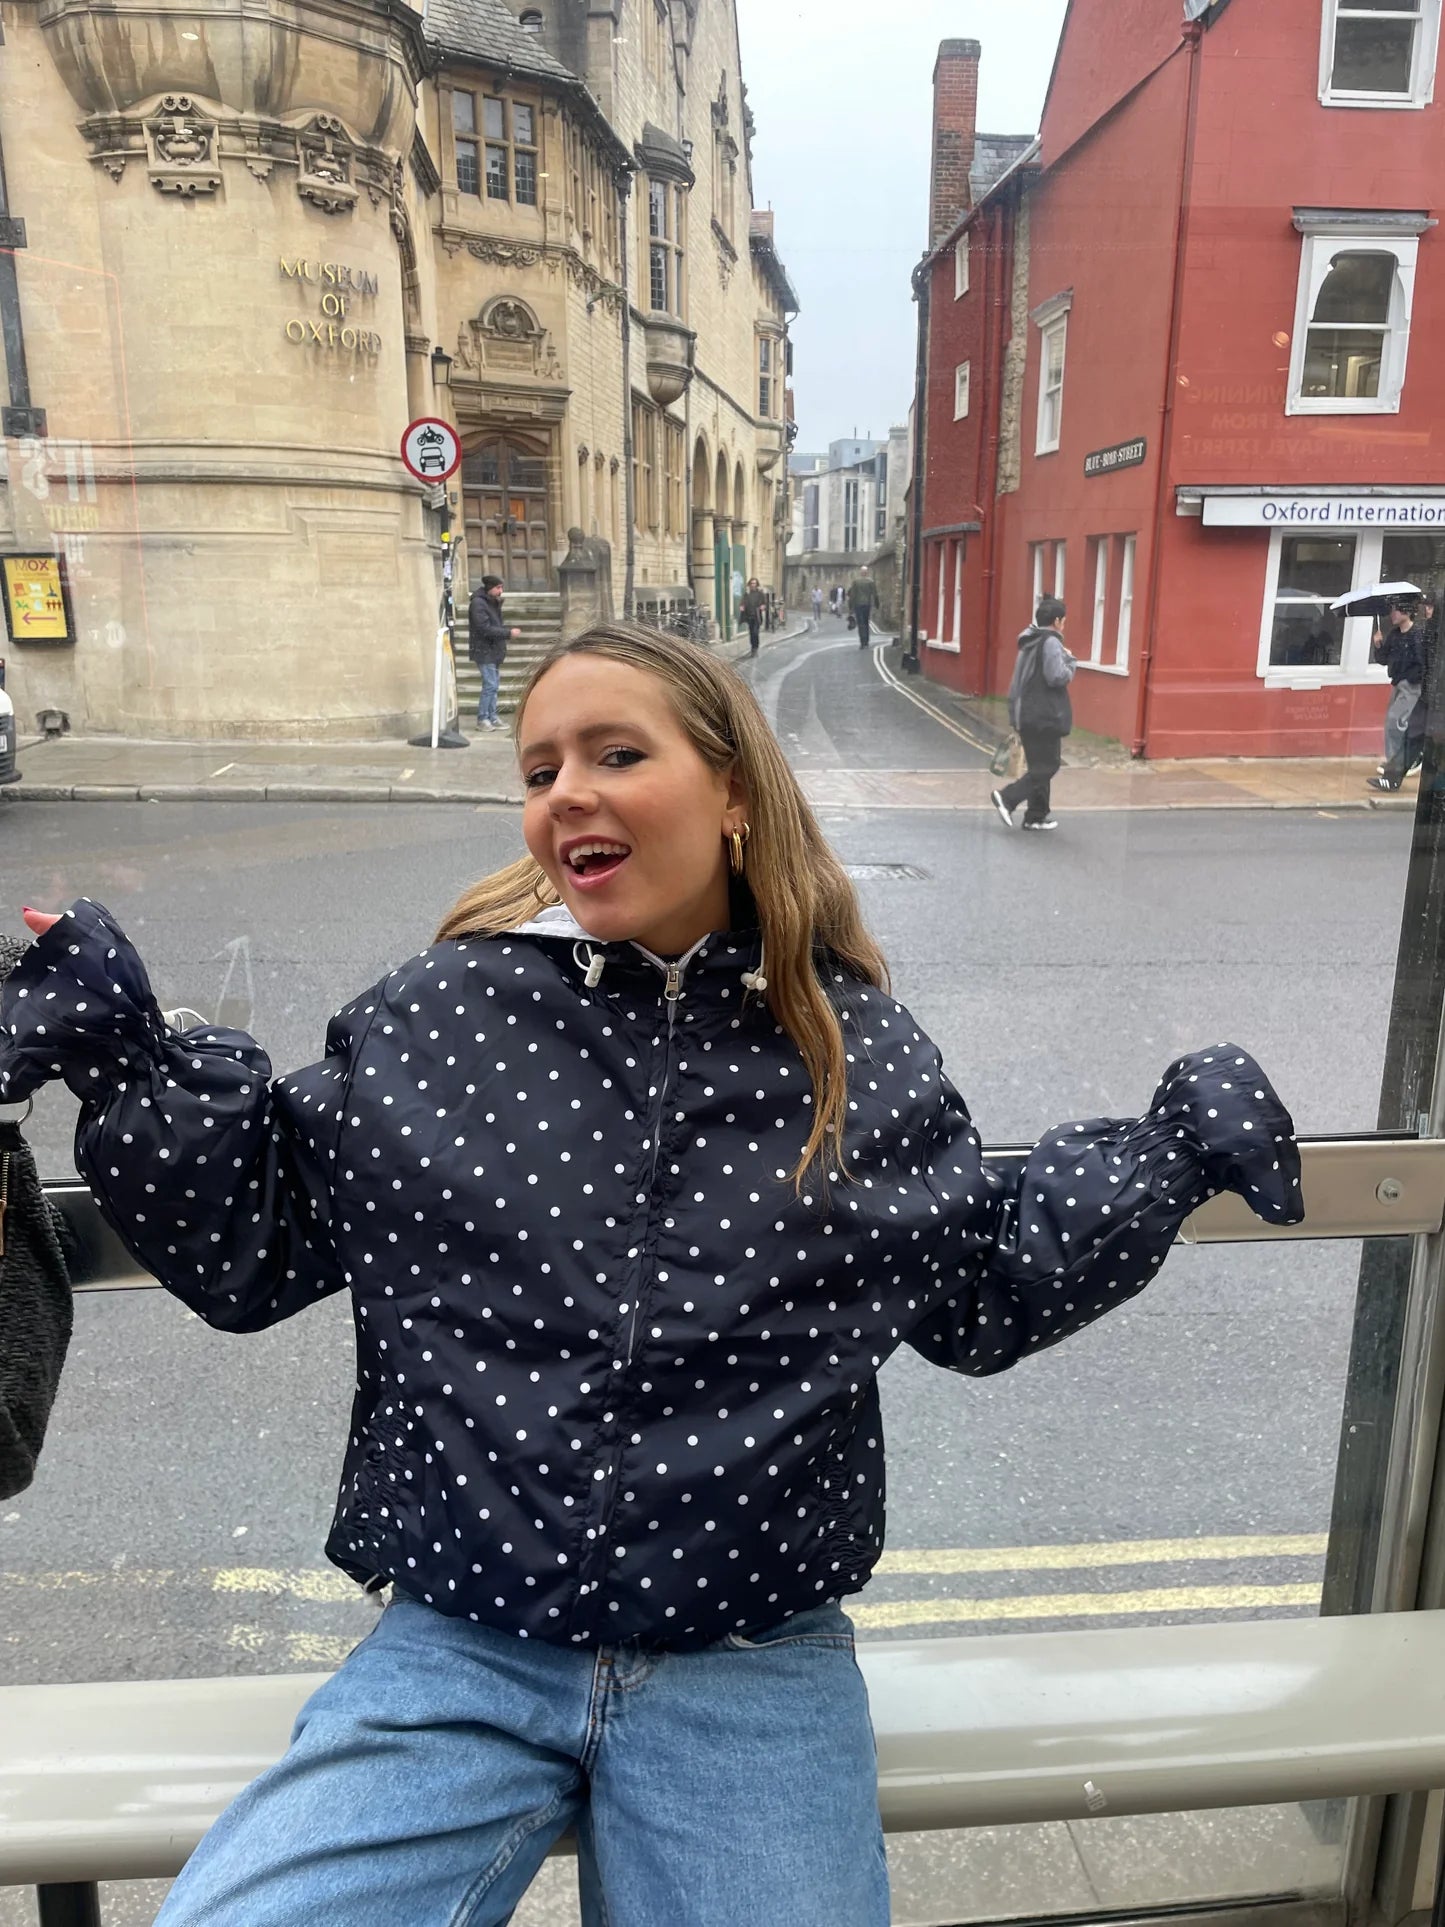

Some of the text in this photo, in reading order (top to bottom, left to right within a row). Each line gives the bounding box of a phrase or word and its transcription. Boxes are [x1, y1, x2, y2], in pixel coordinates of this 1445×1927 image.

[280, 257, 378, 295] MUSEUM
[322, 293, 350, 317] OF
[286, 319, 382, 353] OXFORD
[1118, 442, 1144, 462] STREET
[1262, 502, 1330, 521] Oxford
[15, 559, 50, 572] MOX
